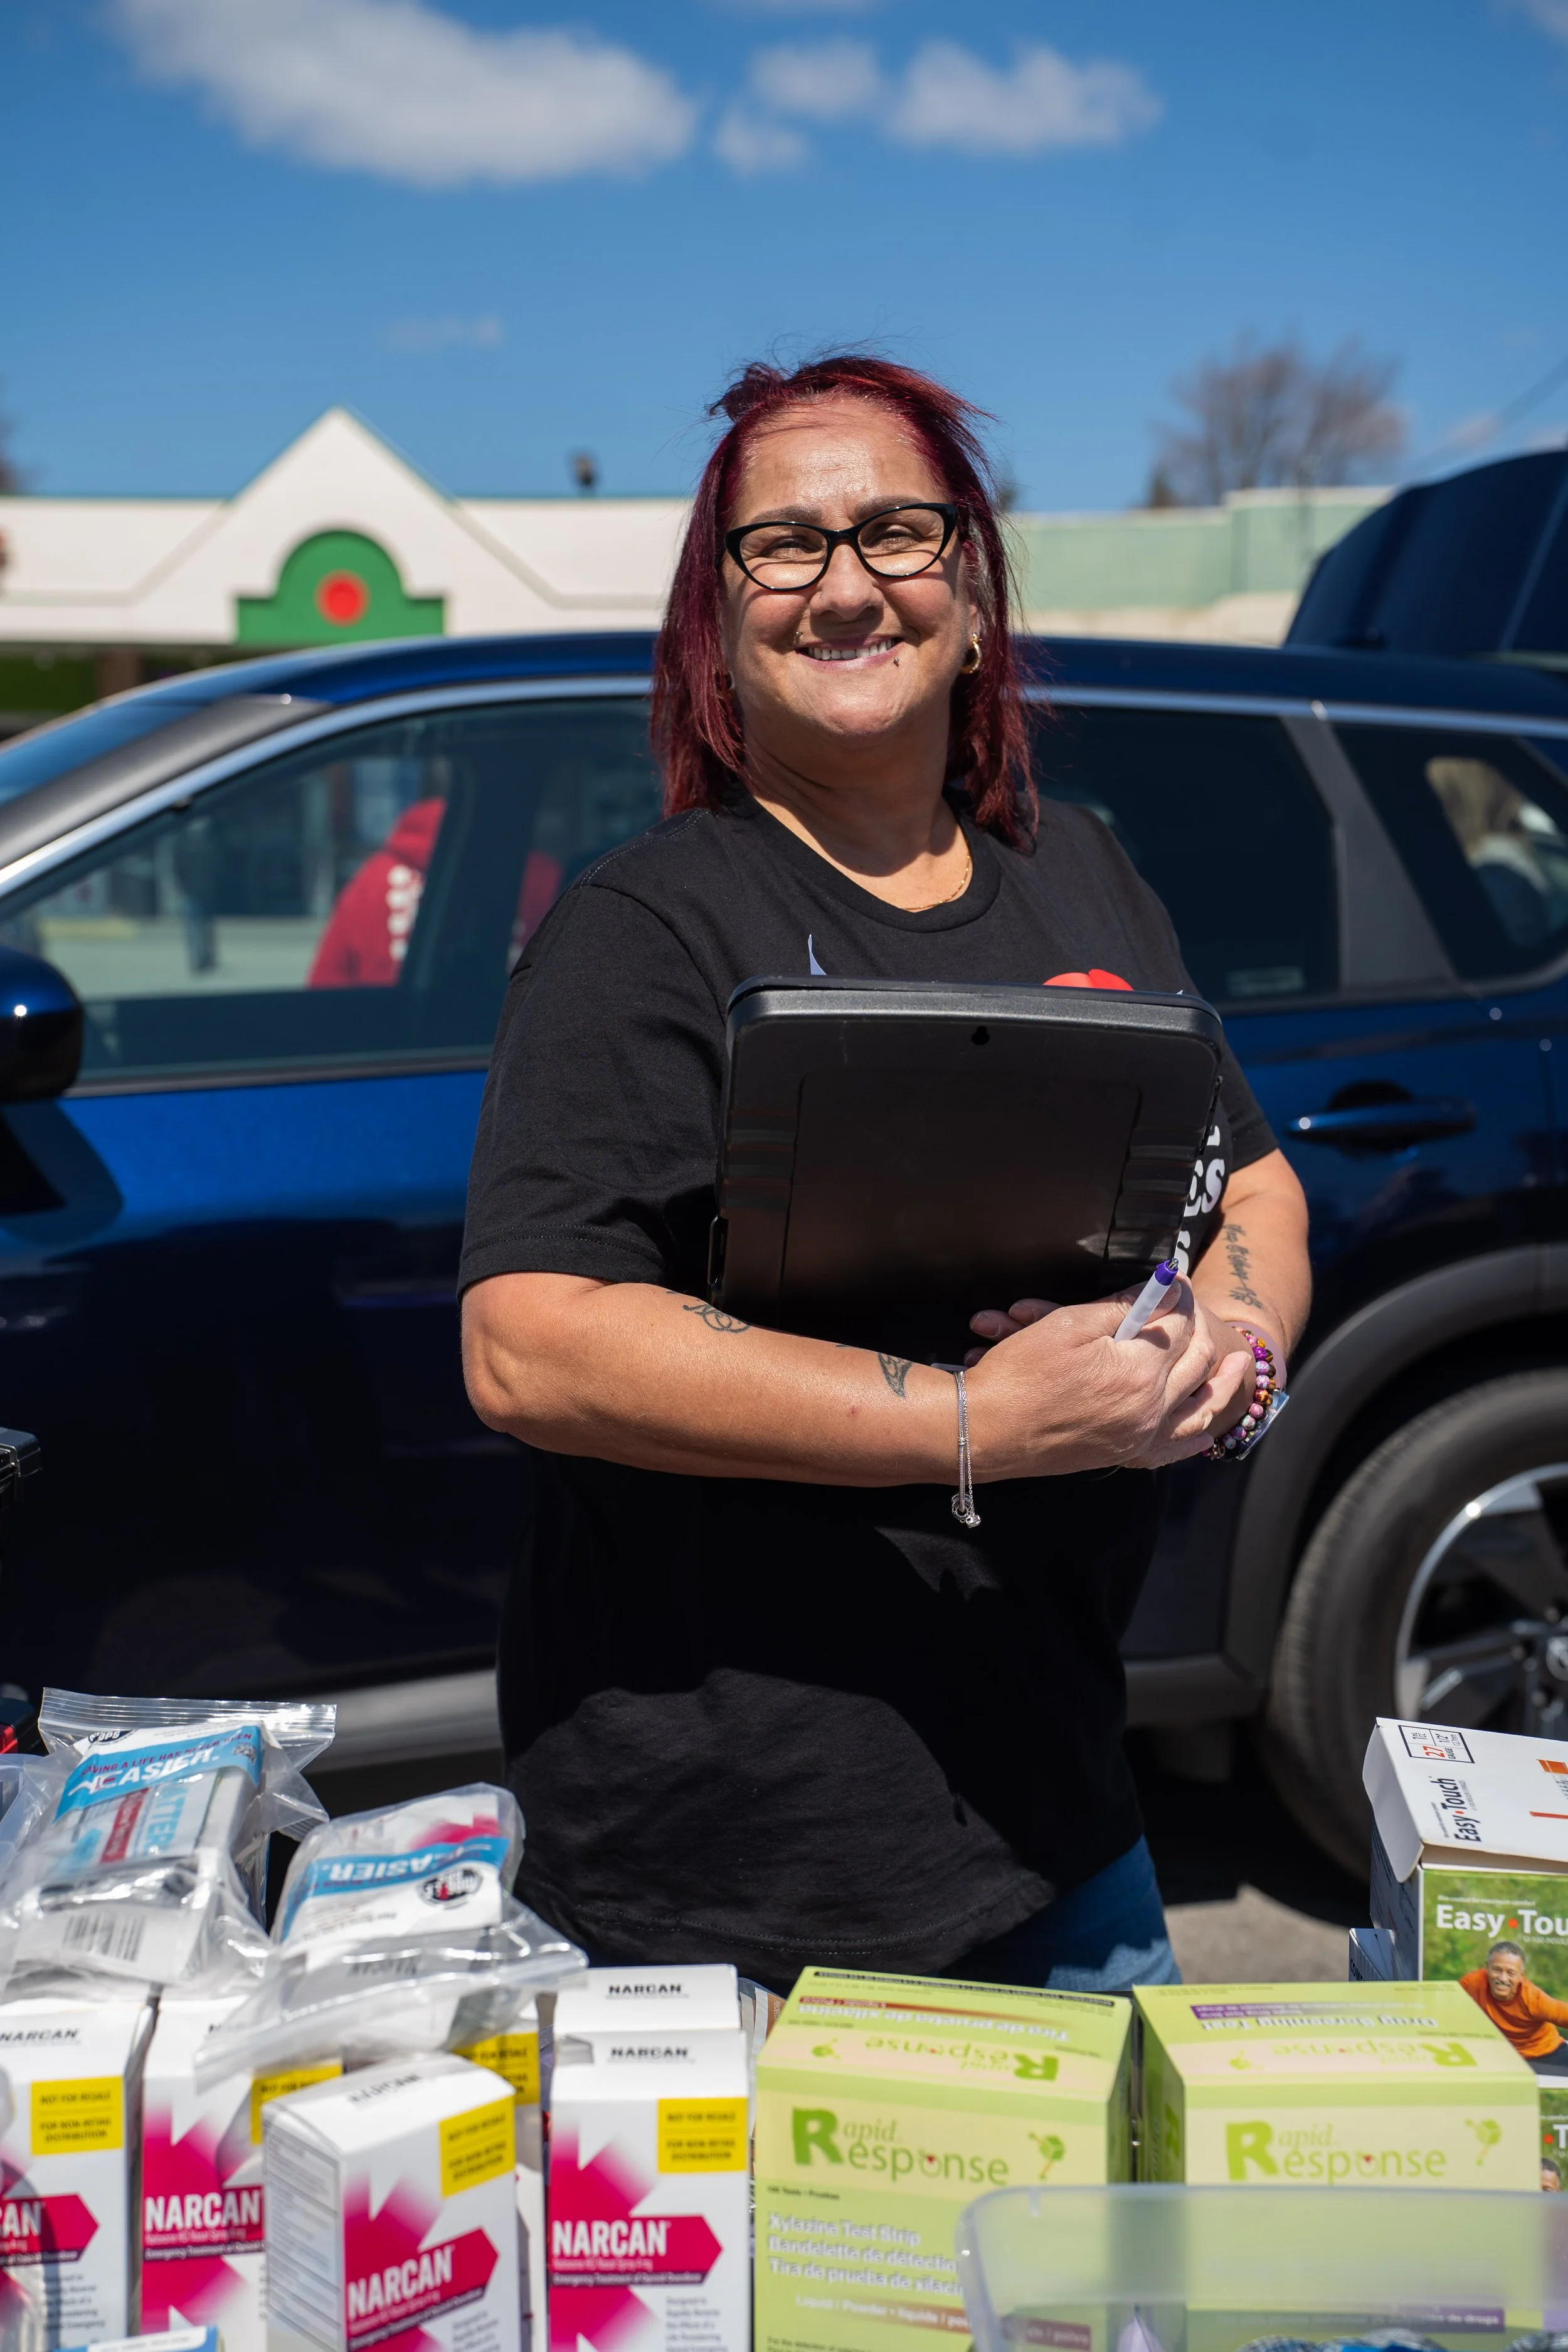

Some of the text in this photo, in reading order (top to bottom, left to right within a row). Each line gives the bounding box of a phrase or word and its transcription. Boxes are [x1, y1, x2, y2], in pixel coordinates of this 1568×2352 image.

[132, 1756, 156, 1767] LIFE
[1422, 1745, 1446, 1758] 27
[1445, 1747, 1456, 1760] GAUGE
[1430, 1777, 1468, 1810] Touch
[1454, 1814, 1482, 1842] Easy
[1436, 1904, 1505, 1939] Easy
[608, 1983, 683, 1995] NARCAN
[0, 2028, 80, 2042] NARCAN
[611, 2047, 689, 2059] NARCAN
[144, 2188, 262, 2232] NARCAN
[552, 2219, 667, 2257] NARCAN
[768, 2212, 921, 2248] Xylazine Test Strip
[348, 2244, 453, 2321] NARCAN
